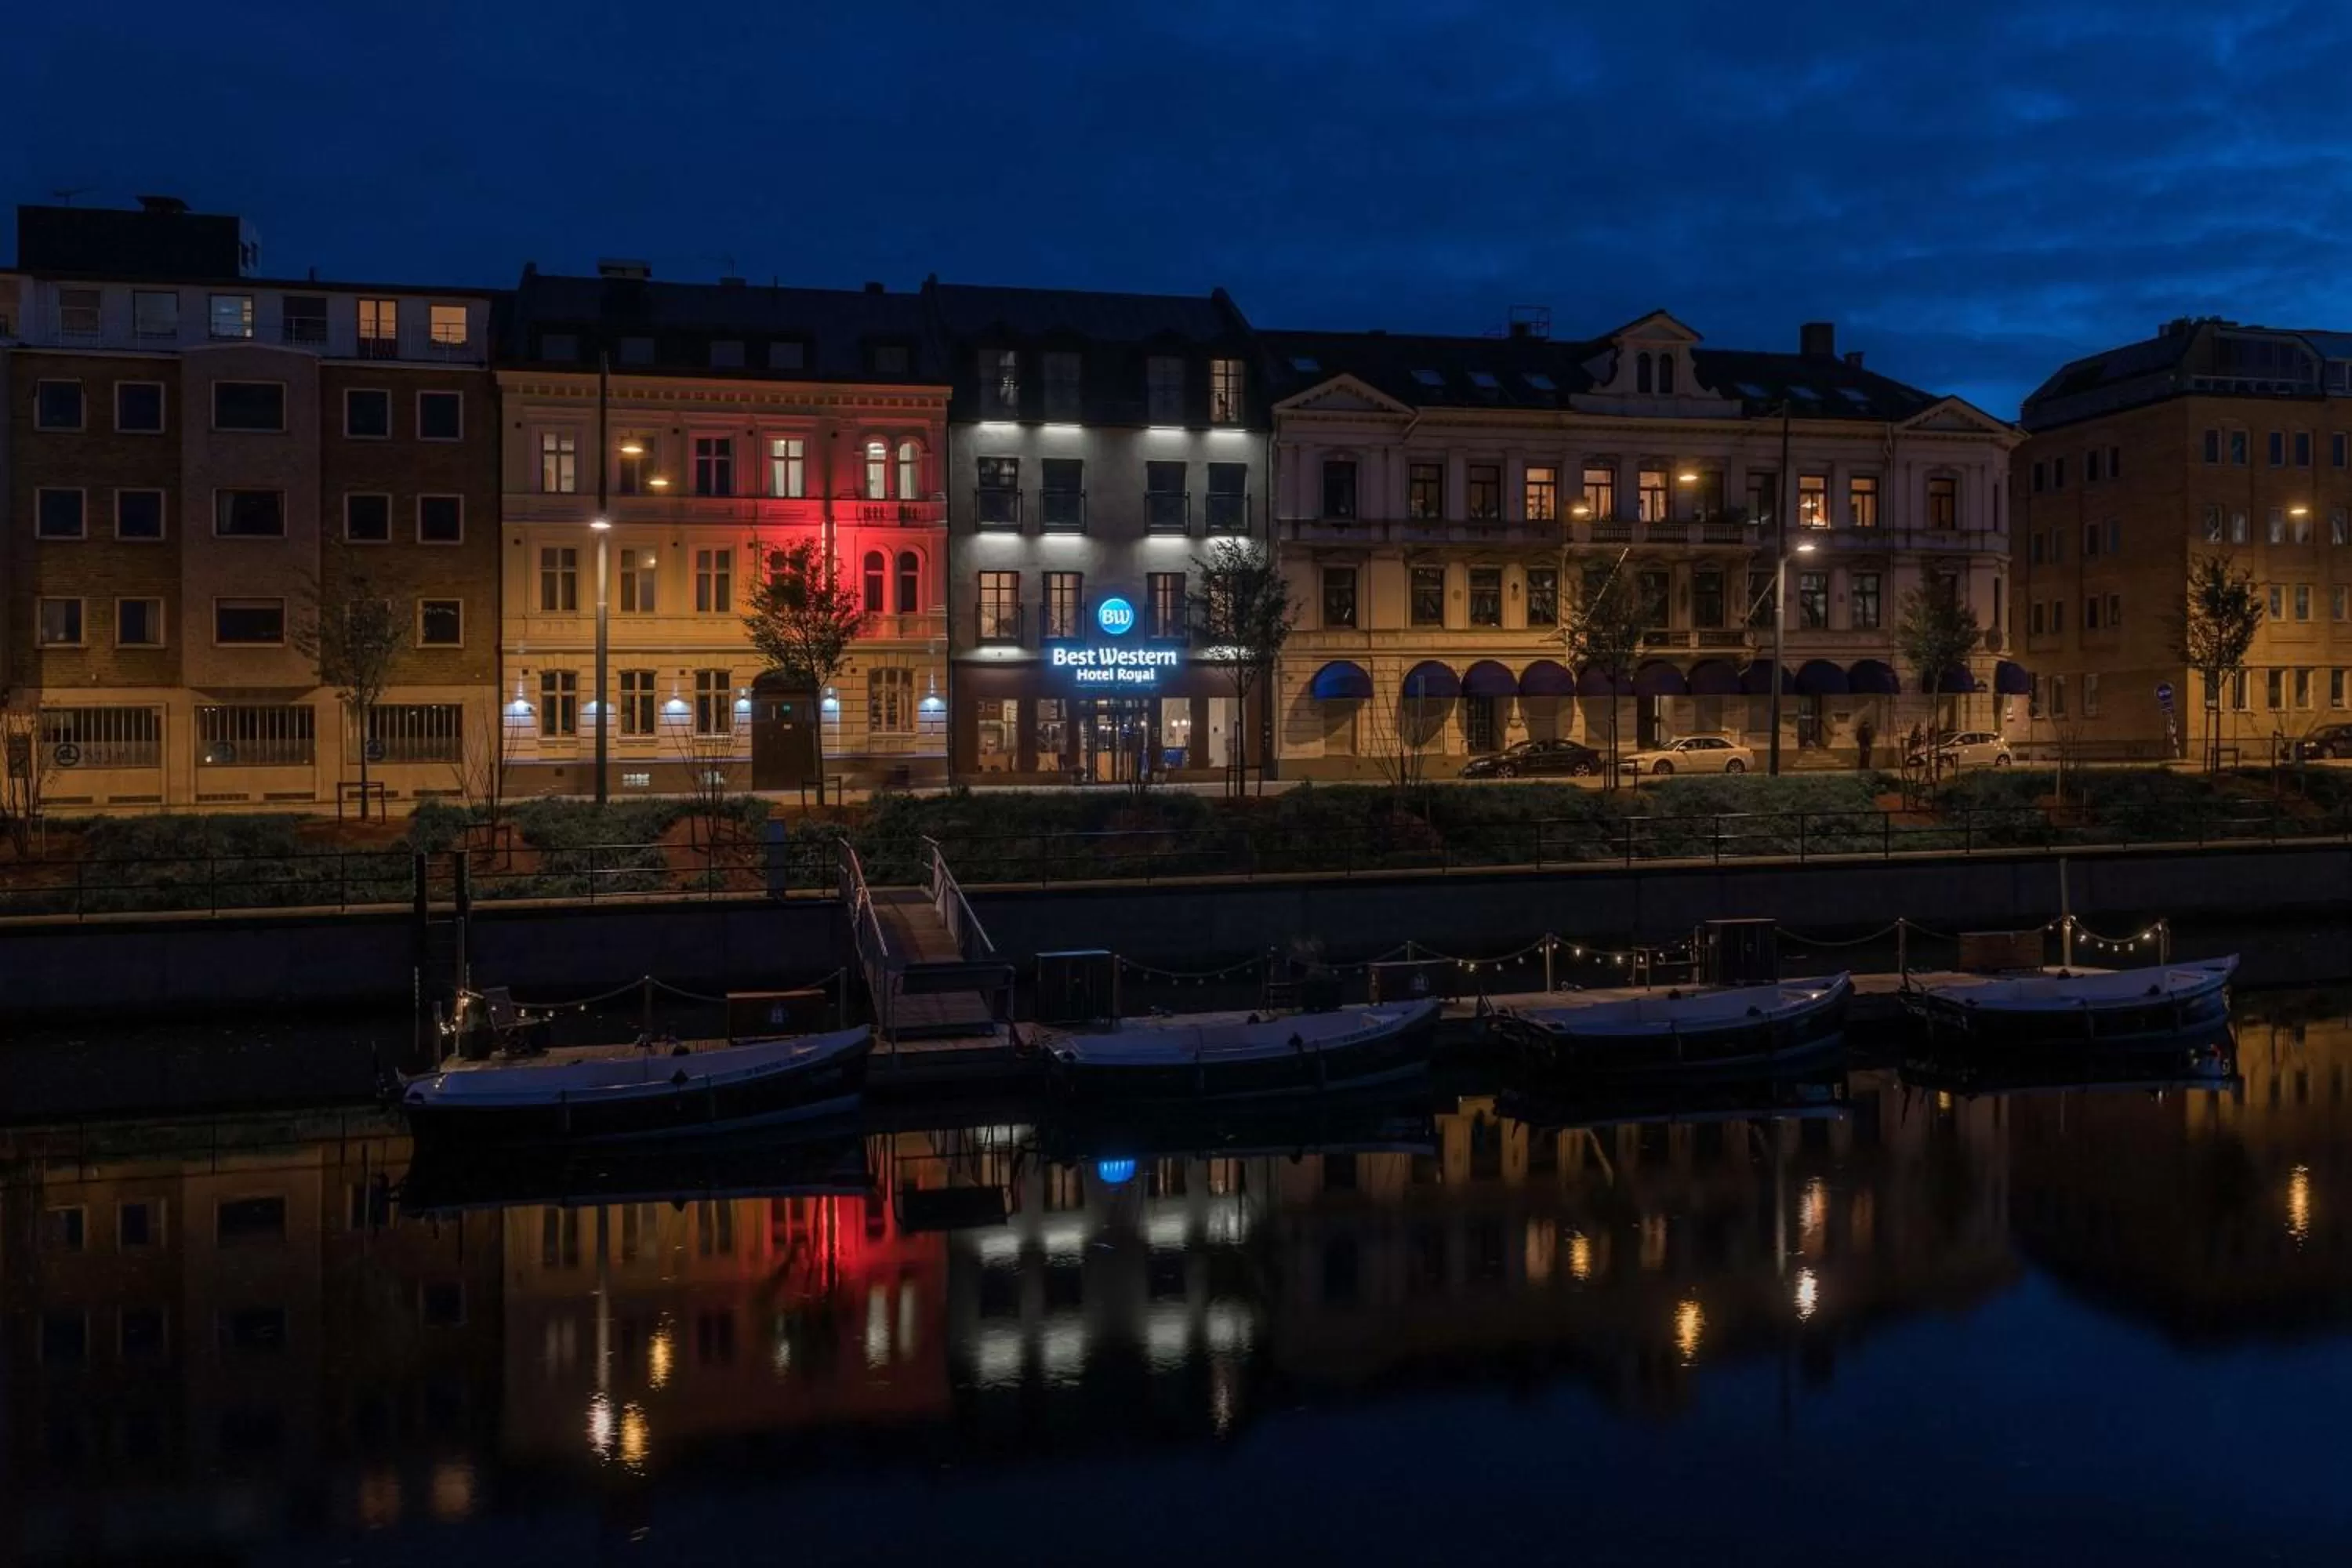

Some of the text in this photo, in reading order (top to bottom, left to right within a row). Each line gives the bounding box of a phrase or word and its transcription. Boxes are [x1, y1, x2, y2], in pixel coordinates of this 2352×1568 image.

[1102, 609, 1130, 625] BW
[1053, 648, 1177, 666] Best Western
[1076, 669, 1155, 682] Hotel Royal
